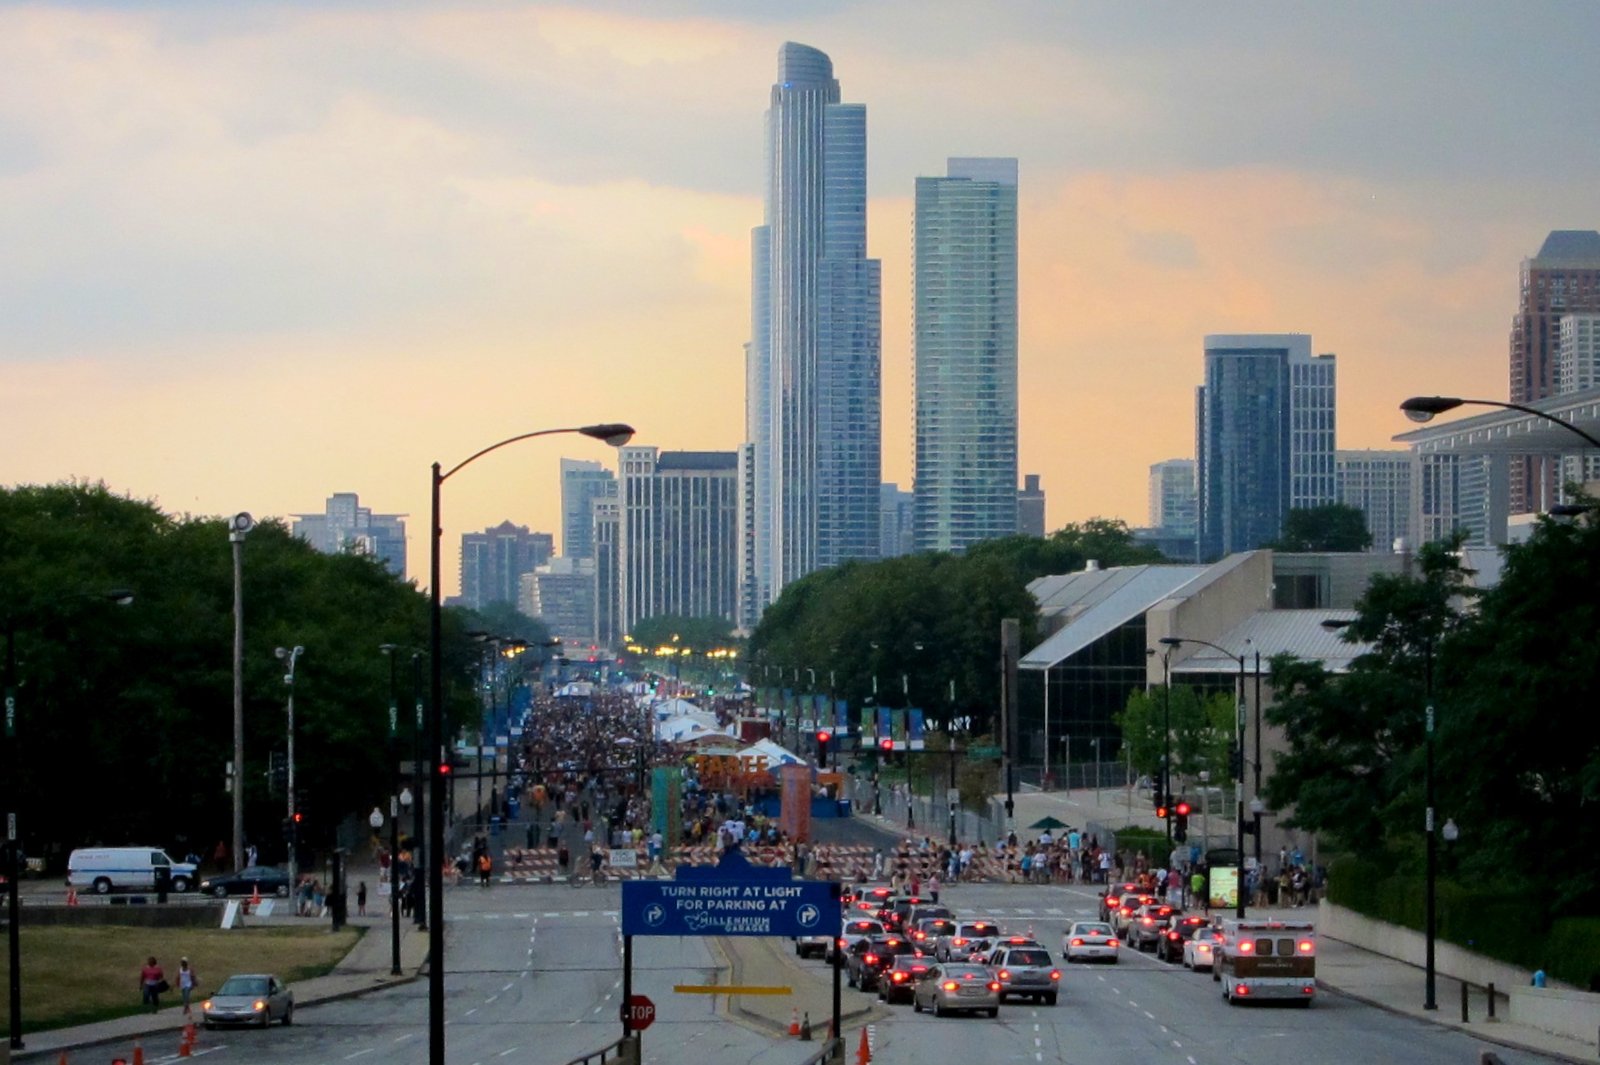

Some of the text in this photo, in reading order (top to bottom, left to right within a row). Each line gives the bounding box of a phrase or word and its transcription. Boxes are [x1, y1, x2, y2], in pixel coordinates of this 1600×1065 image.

[5, 696, 15, 728] C21
[661, 886, 803, 897] TURN RIGHT AT LIGHT
[676, 900, 787, 911] FOR PARKING AT
[700, 916, 770, 926] MILLENNIUM
[725, 924, 770, 932] GARAGES
[630, 1005, 654, 1020] TOP
